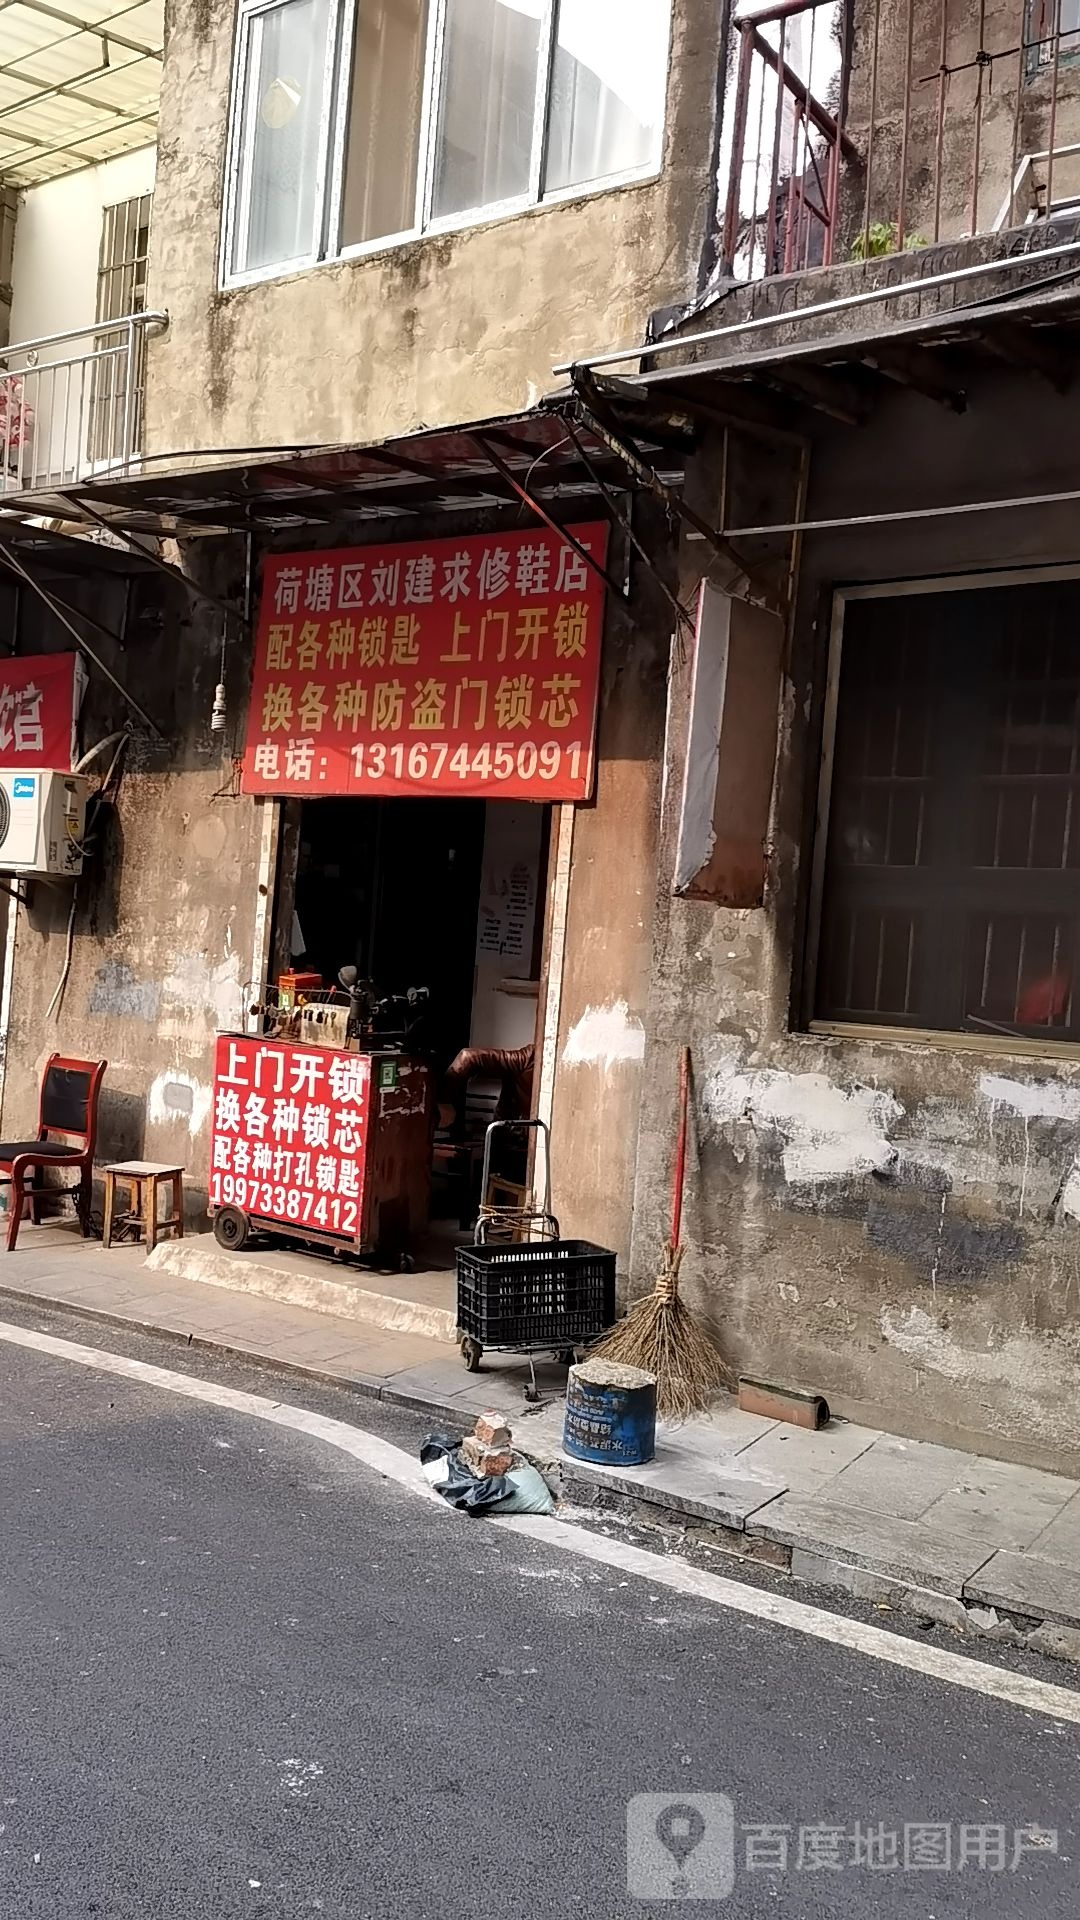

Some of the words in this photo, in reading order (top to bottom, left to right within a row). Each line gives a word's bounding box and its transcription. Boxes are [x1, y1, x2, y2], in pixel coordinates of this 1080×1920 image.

[274, 537, 592, 614] 荷塘区刘建求修鞋店
[265, 614, 421, 671] 配各种锁匙
[440, 601, 590, 662] 上门开锁
[261, 673, 582, 732] 换各种防盗门锁芯
[350, 740, 583, 780] 13167445091
[217, 1042, 364, 1106] 上门开锁
[215, 1087, 363, 1154] 换各种锁芯
[213, 1135, 360, 1198] 配各种打孔锁匙
[210, 1172, 358, 1233] 19973387412
